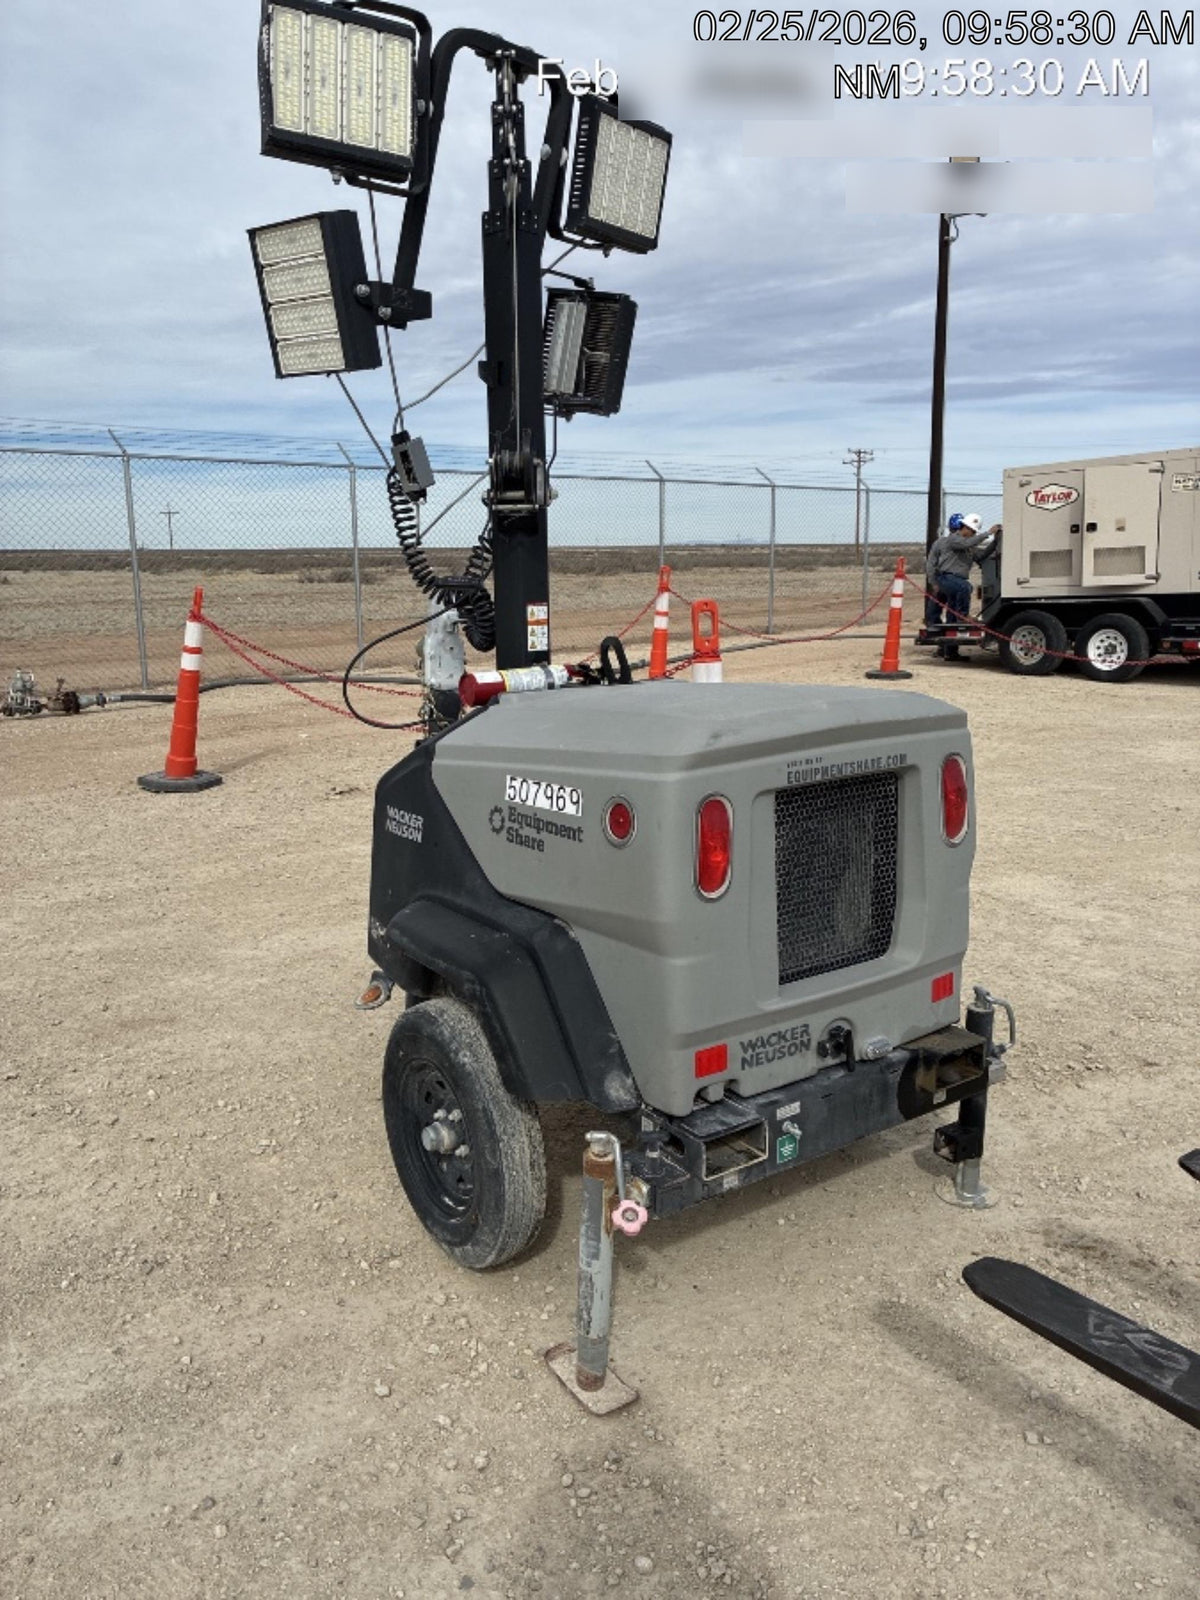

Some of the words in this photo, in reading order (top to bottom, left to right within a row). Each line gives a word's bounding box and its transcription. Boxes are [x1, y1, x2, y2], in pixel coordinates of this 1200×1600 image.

[787, 753, 908, 784] EQUIPMENTSHARE.COM
[507, 776, 581, 815] 507969
[385, 818, 423, 843] NEUSON
[386, 804, 425, 829] WACKER
[507, 805, 585, 843] Equipment
[505, 826, 546, 853] Share
[739, 1023, 811, 1055] WACKER
[741, 1038, 812, 1071] NEUSON
